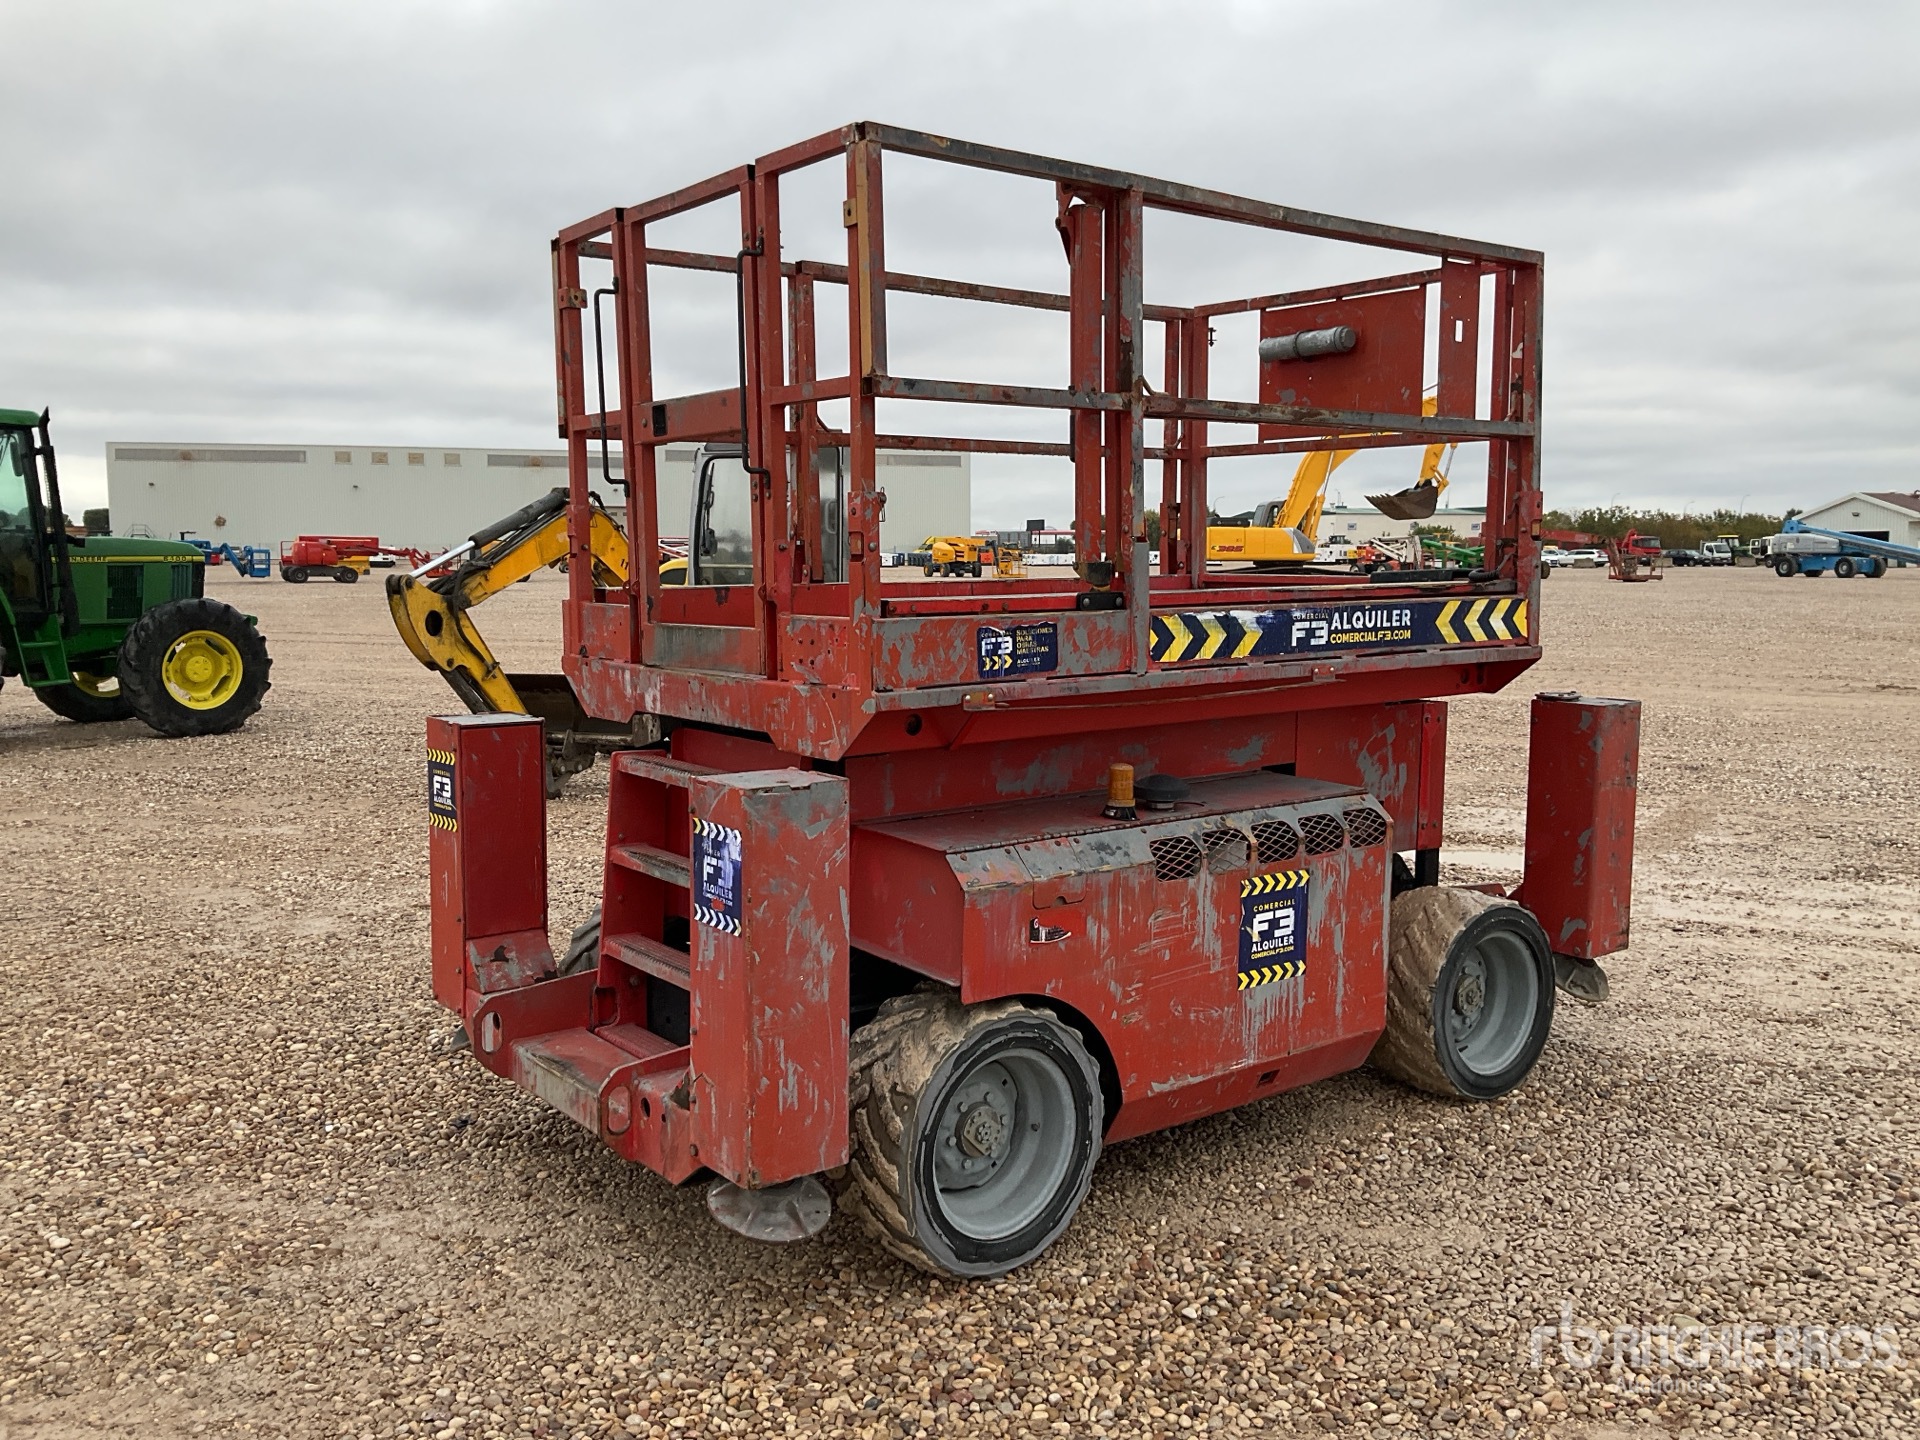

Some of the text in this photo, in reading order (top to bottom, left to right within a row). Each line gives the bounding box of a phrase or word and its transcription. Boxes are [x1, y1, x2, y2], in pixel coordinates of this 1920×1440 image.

[1292, 612, 1329, 620] COMERCIAL
[1330, 609, 1411, 630] ALQUILER
[1291, 620, 1329, 647] F3
[1330, 629, 1411, 644] COMERCIALF3.COM
[981, 635, 1013, 656] F3
[433, 774, 451, 799] F3
[703, 855, 734, 890] F3
[1253, 899, 1296, 912] COMERCIAL
[1252, 907, 1295, 943] F3
[1251, 935, 1294, 953] ALQUILER
